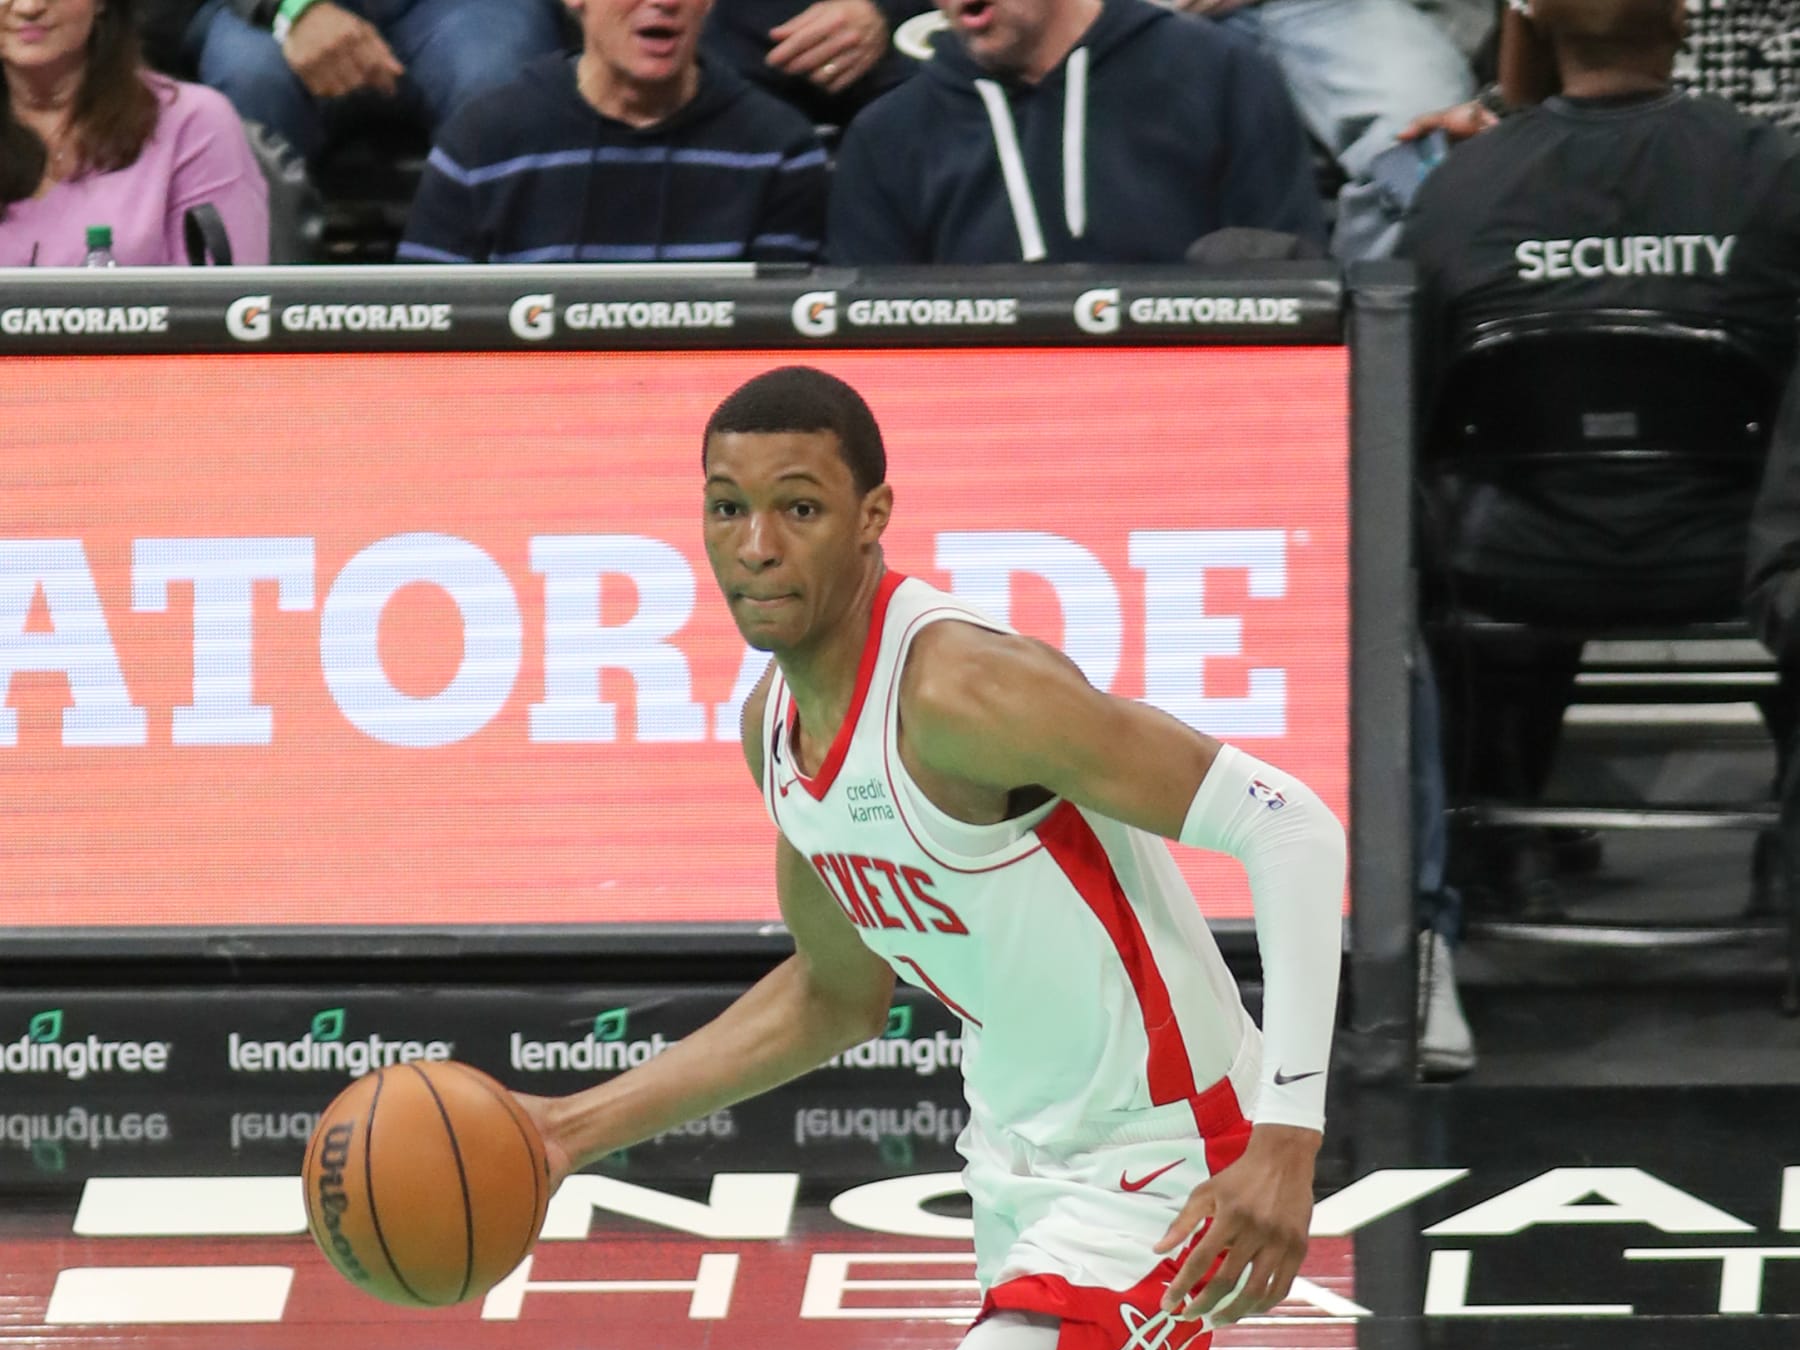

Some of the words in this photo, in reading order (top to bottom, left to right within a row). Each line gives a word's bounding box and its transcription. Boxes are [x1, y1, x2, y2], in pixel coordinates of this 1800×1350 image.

[1515, 235, 1737, 280] SECURITY
[0, 306, 169, 334] GATORADE
[281, 304, 451, 331] GATORADE
[564, 302, 735, 329] GATORADE
[847, 298, 1018, 325] GATORADE
[1129, 296, 1302, 323] GATORADE
[845, 778, 886, 801] credit
[848, 803, 895, 823] karma
[811, 853, 970, 936] CKETS
[0, 1034, 167, 1079] dingtree
[230, 1033, 449, 1076] lendingtree
